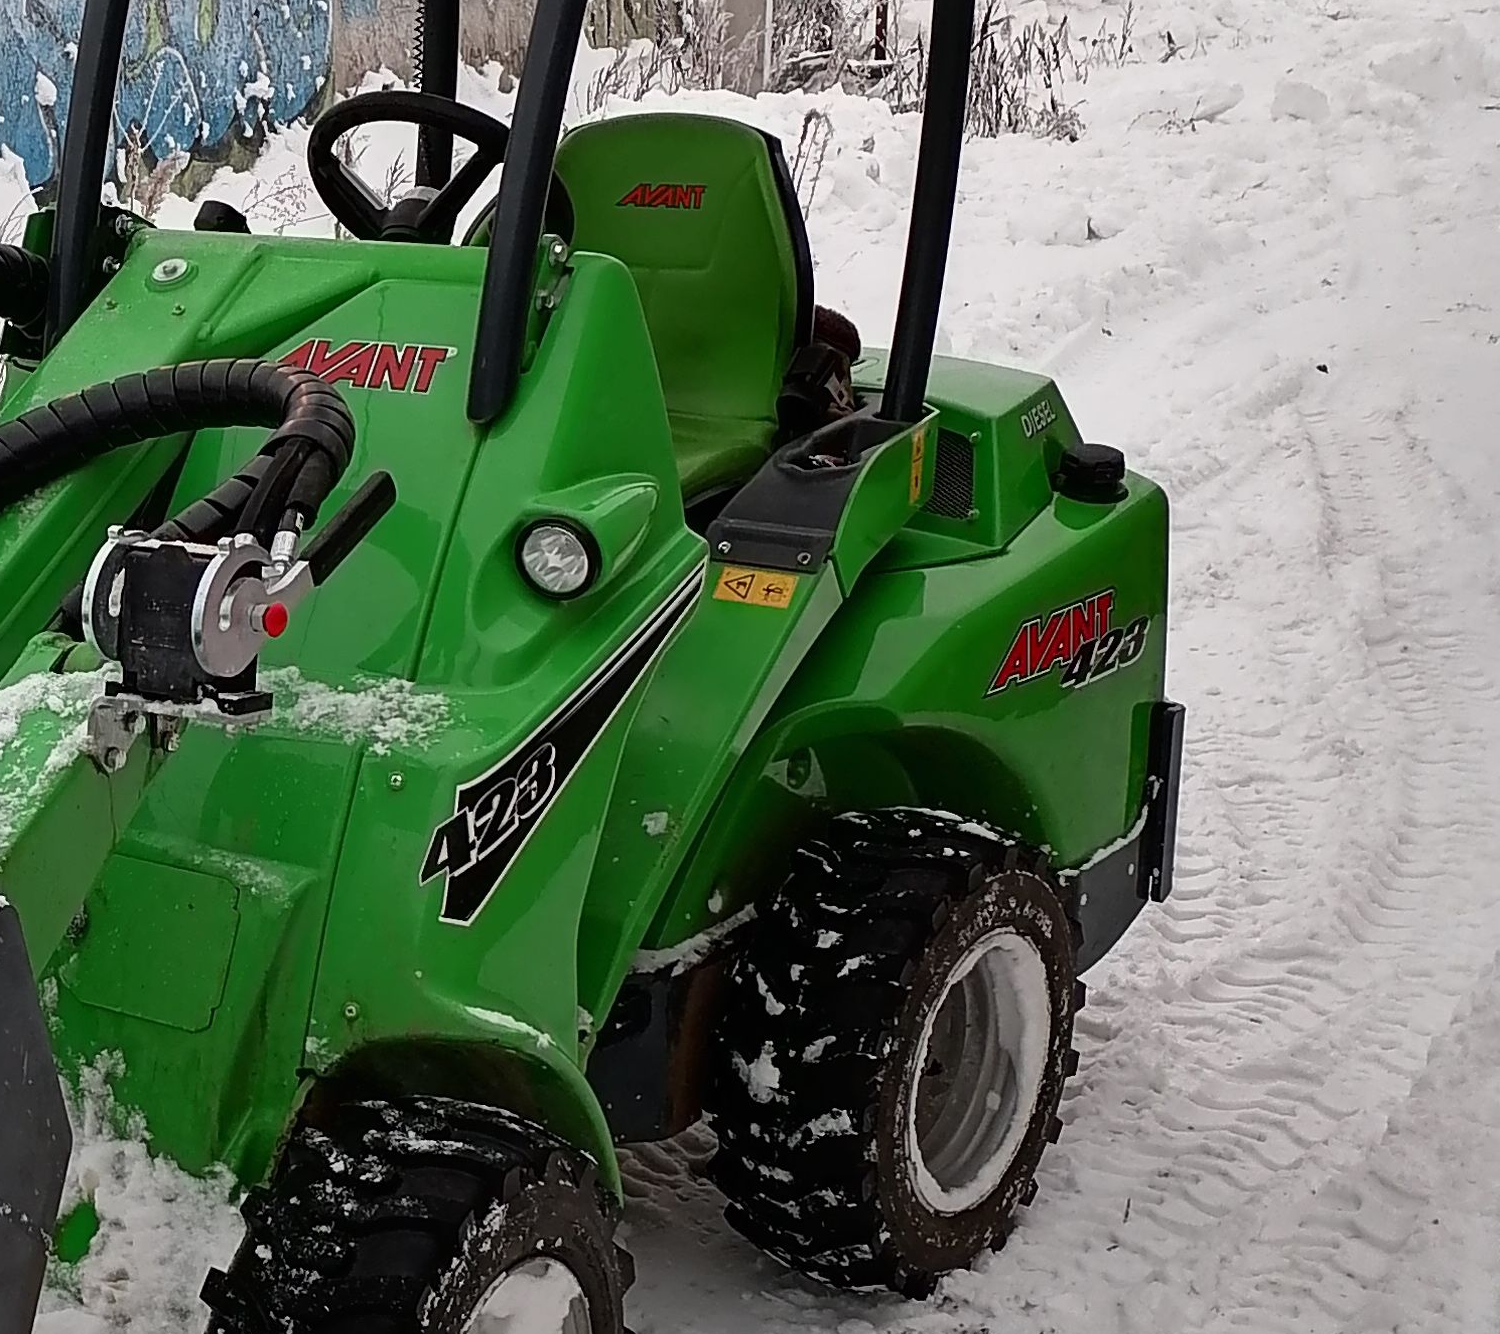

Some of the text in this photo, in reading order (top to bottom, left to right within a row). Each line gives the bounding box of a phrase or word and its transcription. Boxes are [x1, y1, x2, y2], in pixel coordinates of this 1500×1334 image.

[616, 183, 706, 208] AVANT
[277, 339, 451, 394] AVANT
[1021, 399, 1056, 437] DIESEL
[985, 588, 1116, 696] AVANT
[1060, 616, 1151, 689] 423
[419, 742, 556, 887] 423
